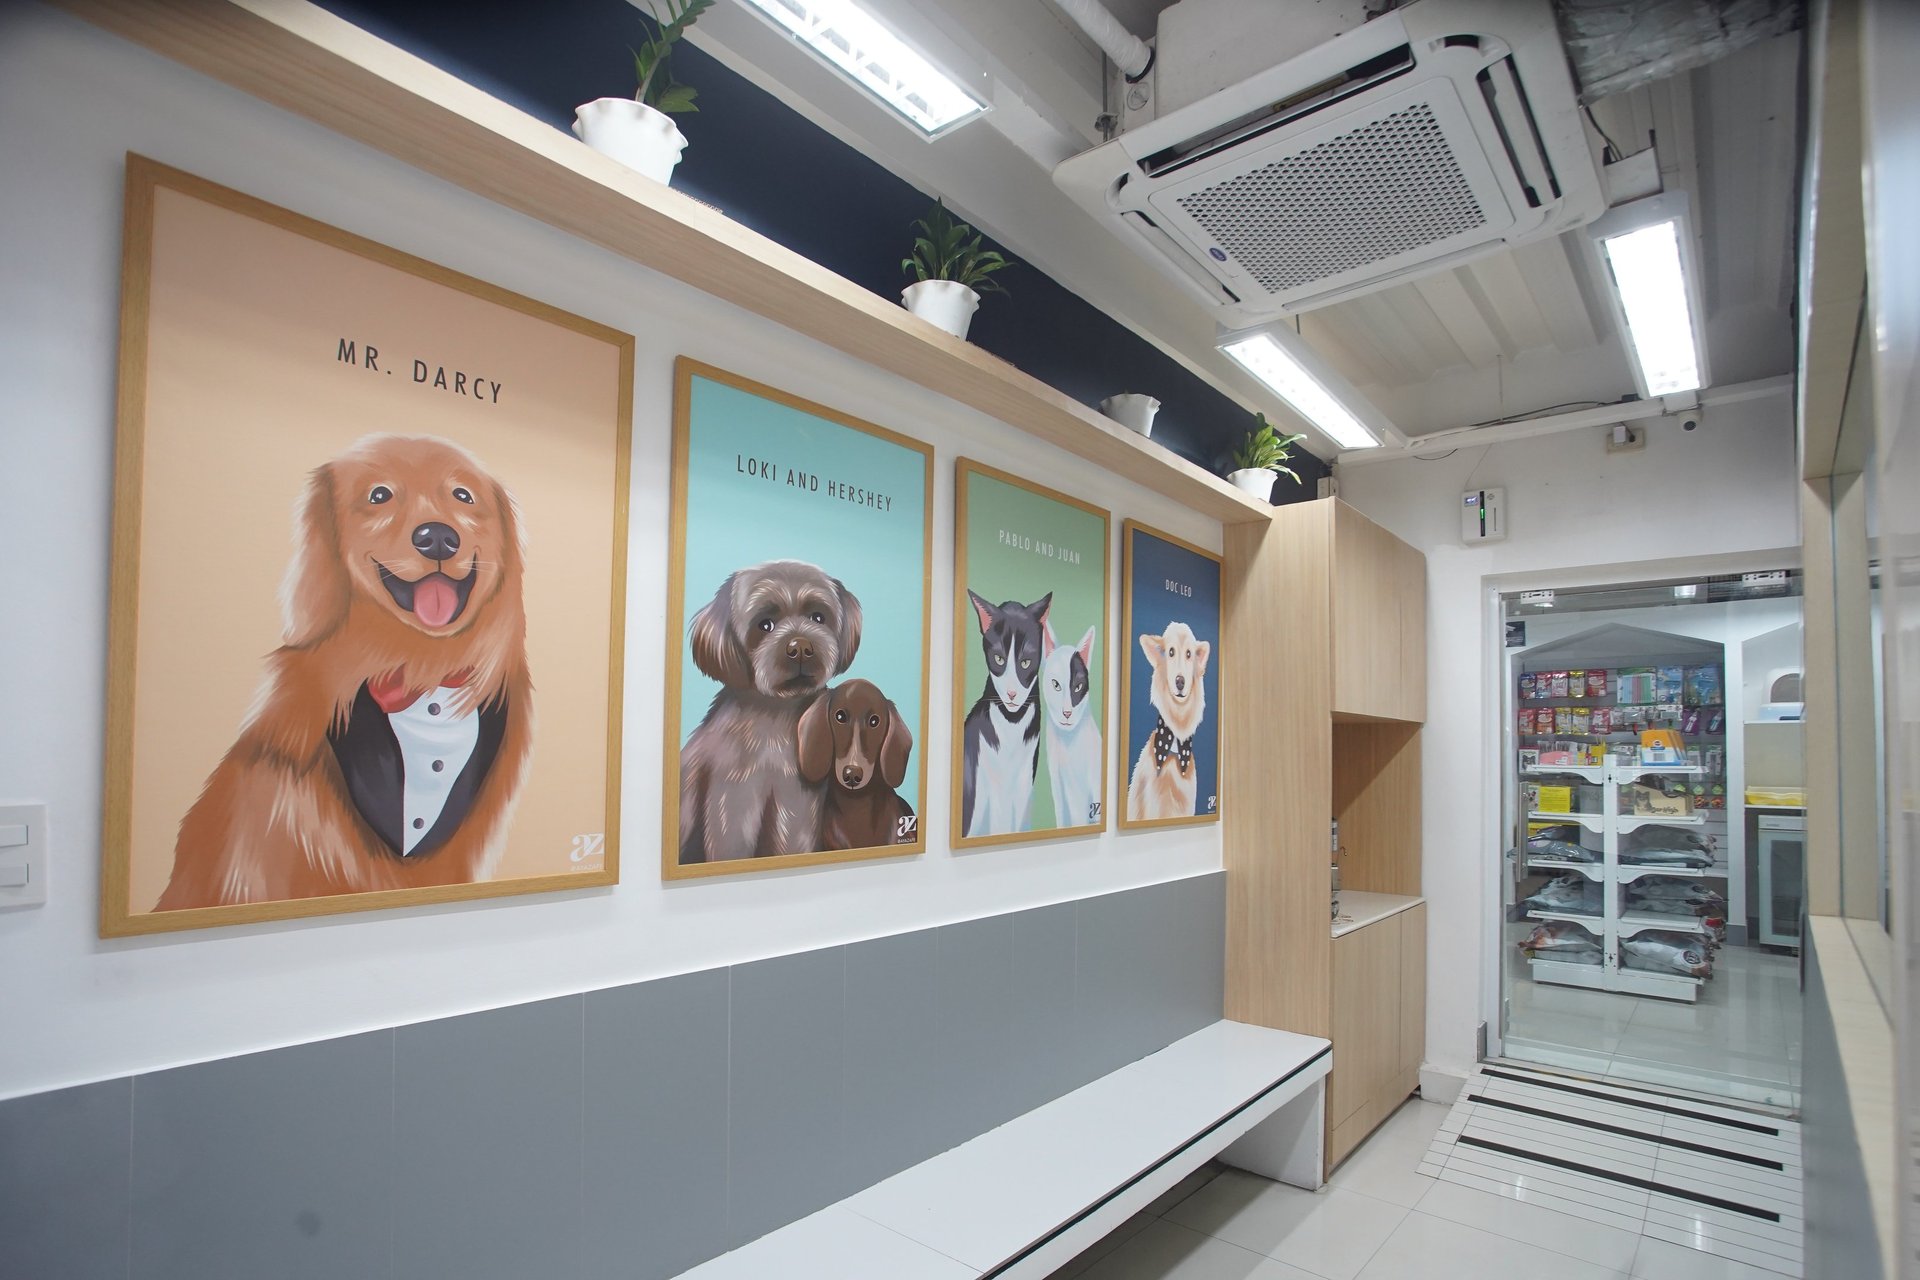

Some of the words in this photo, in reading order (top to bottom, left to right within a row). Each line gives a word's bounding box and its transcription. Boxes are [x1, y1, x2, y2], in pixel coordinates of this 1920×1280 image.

[337, 338, 392, 375] MR.
[413, 359, 502, 404] DARCY
[737, 454, 776, 481] LOKI
[786, 469, 819, 492] AND
[828, 480, 892, 512] HERSHEY
[999, 529, 1030, 551] PABLO
[1035, 540, 1054, 557] AND
[1058, 547, 1080, 565] JUAN
[1165, 579, 1178, 593] DOC
[1180, 584, 1192, 598] LEO
